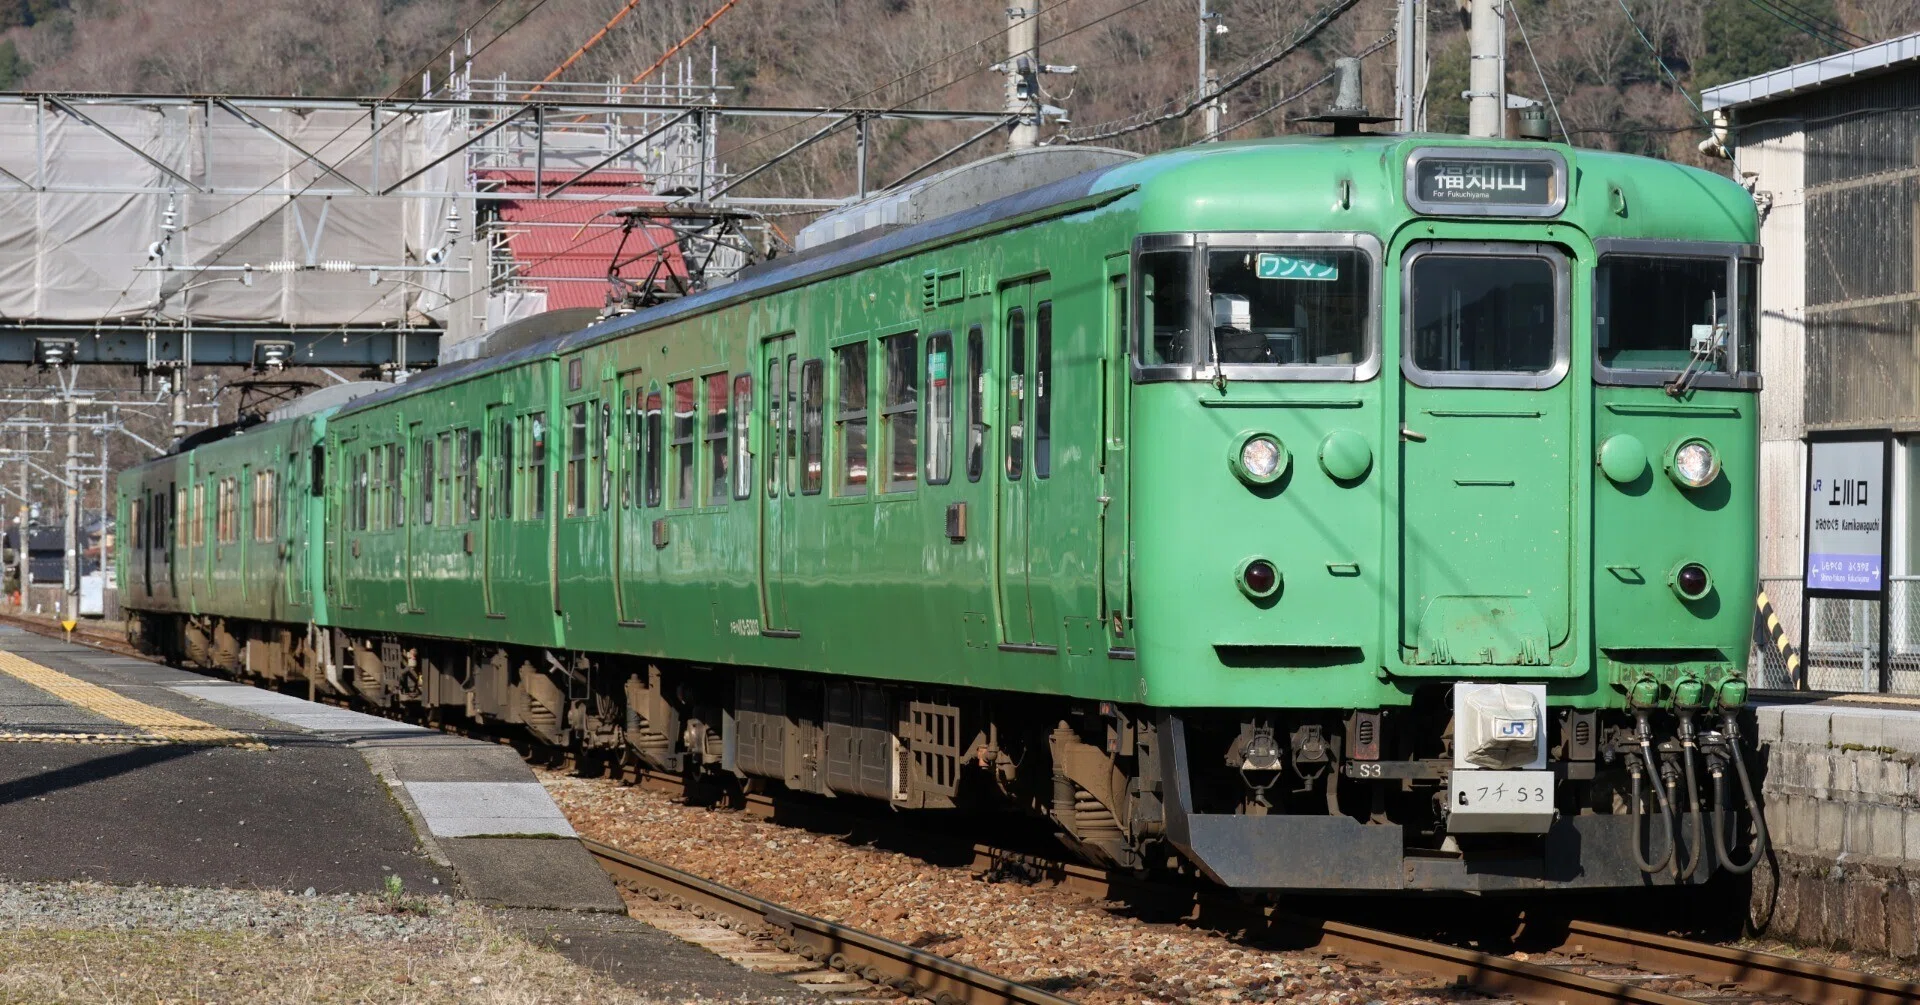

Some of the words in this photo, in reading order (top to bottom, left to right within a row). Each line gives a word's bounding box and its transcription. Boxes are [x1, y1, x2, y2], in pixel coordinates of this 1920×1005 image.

[1434, 164, 1526, 191] 福知山
[1433, 190, 1444, 198] For
[1447, 190, 1490, 199] Fukuchiyama
[1813, 479, 1822, 491] JR
[1829, 479, 1868, 506] 上川口
[1503, 722, 1524, 735] JR
[1359, 764, 1381, 777] S3
